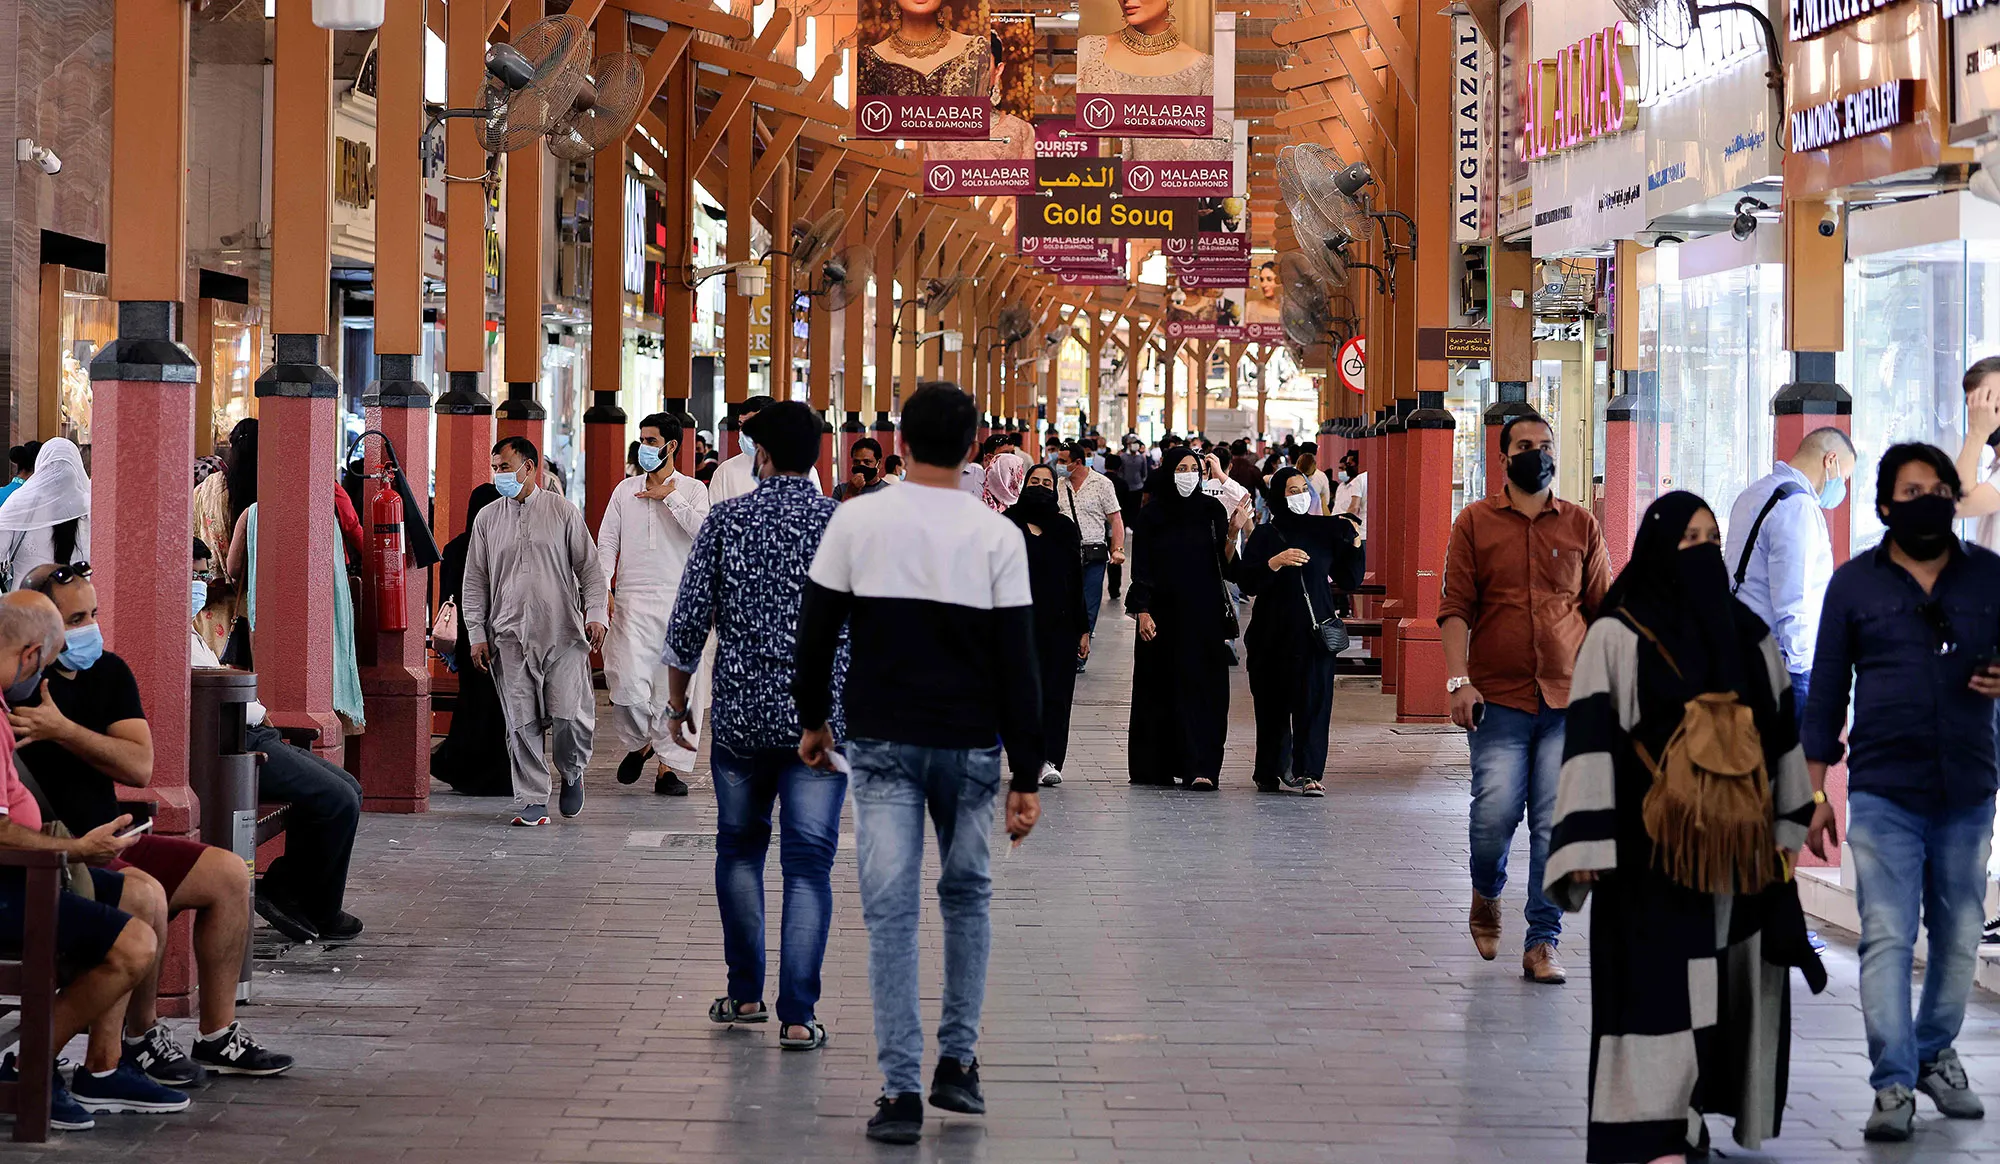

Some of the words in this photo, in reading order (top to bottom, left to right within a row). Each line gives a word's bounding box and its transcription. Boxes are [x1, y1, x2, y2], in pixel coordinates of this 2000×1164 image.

[1551, 20, 1625, 151] ALMAS
[901, 106, 983, 119] MALABAR
[1123, 104, 1206, 117] MALABAR
[1791, 99, 1840, 153] DIAMONDS
[1843, 79, 1900, 139] JEWELLERY
[901, 120, 926, 128] GOLD
[935, 120, 983, 128] DIAMONDS
[1124, 118, 1149, 126] GOLD
[1150, 118, 1157, 126] &
[1158, 118, 1206, 127] DIAMONDS
[1460, 26, 1478, 230] ALGHAZAL
[961, 168, 1030, 179] MALABAR
[1039, 166, 1114, 187] الذهب
[1160, 169, 1228, 180] MALABAR
[1043, 203, 1101, 225] Gold
[1110, 203, 1174, 231] Souq
[1470, 344, 1488, 353] Souq
